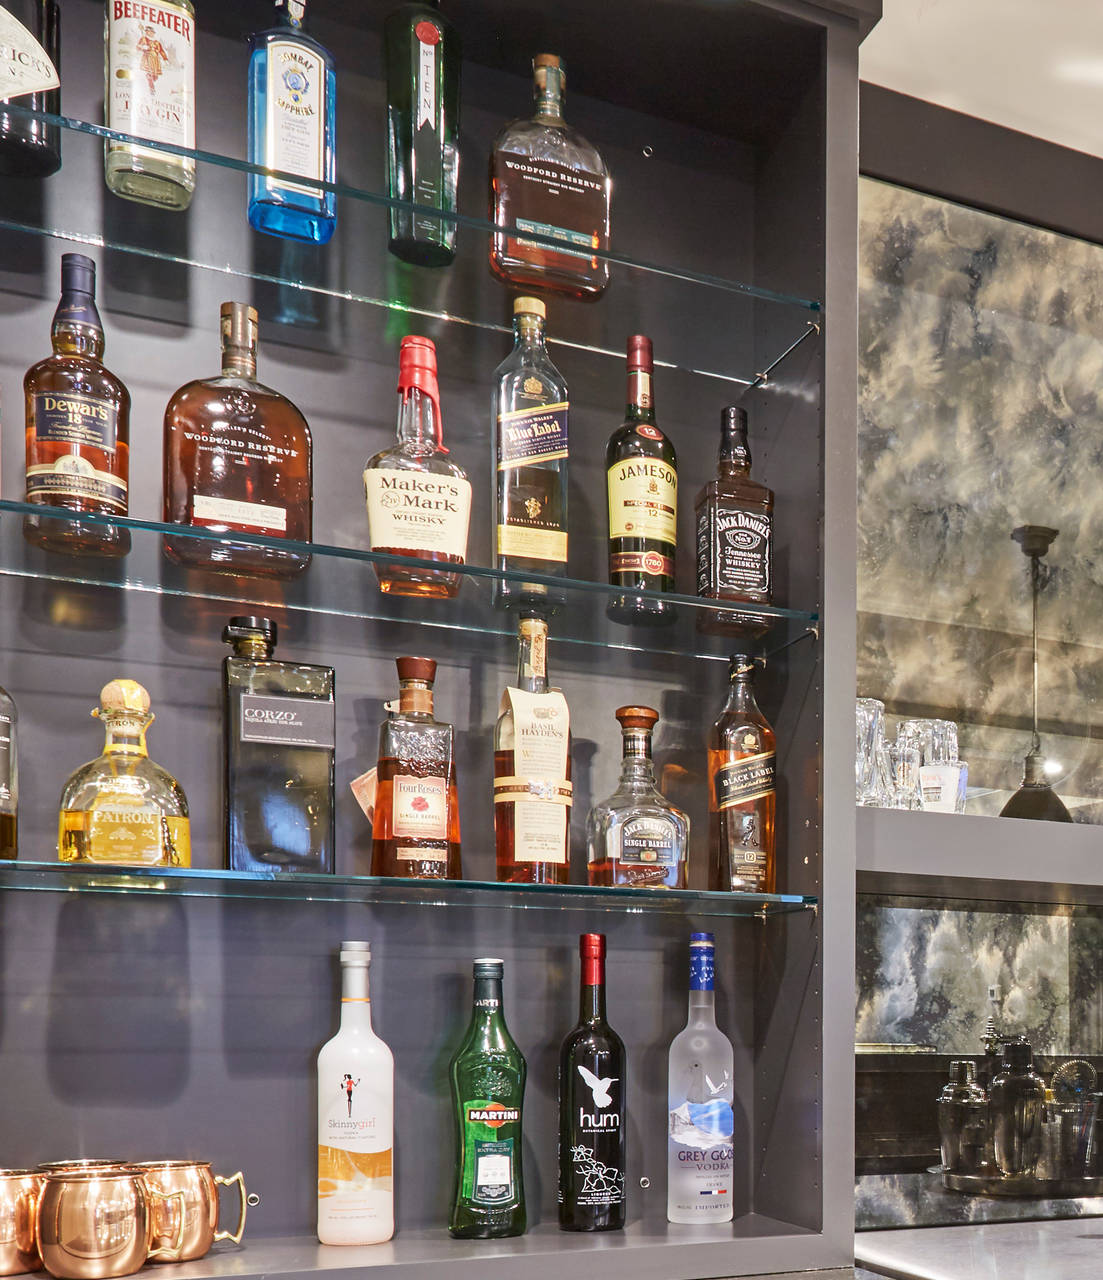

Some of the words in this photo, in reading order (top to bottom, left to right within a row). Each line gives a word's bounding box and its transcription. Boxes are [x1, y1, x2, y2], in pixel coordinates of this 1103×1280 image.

[114, 0, 190, 43] BEEFEATER
[279, 51, 314, 72] BOMBAY
[278, 97, 316, 116] SAPPHIRE
[505, 160, 558, 178] WOODFORD
[560, 173, 602, 190] RESERVE
[44, 397, 108, 420] Dewar's
[67, 413, 82, 424] 18
[506, 426, 533, 442] Blue
[531, 420, 562, 439] Label
[247, 441, 298, 458] RESERVE
[619, 464, 677, 489] JAMESON
[381, 477, 459, 497] Maker's
[403, 495, 458, 513] Mark
[392, 513, 446, 524] WHISKY
[648, 509, 658, 517] 12
[716, 516, 738, 532] JACK
[737, 513, 772, 538] DANIEL'S
[724, 546, 761, 559] Tennessee
[645, 558, 662, 567] 1780
[725, 558, 761, 569] WHISKEY
[245, 708, 295, 721] CORZO
[723, 775, 750, 787] BLACK
[750, 766, 774, 782] LABEL
[399, 782, 417, 793] Four
[417, 783, 442, 795] Roses
[624, 824, 643, 837] JACK
[624, 839, 647, 847] SINGLE
[648, 840, 672, 849] BARREL
[746, 853, 755, 861] 12
[470, 1110, 518, 1121] MARTINI
[579, 1107, 620, 1128] hum
[328, 1117, 376, 1131] Skinnygirl
[678, 1150, 707, 1162] GREY
[696, 1162, 730, 1171] VODKA
